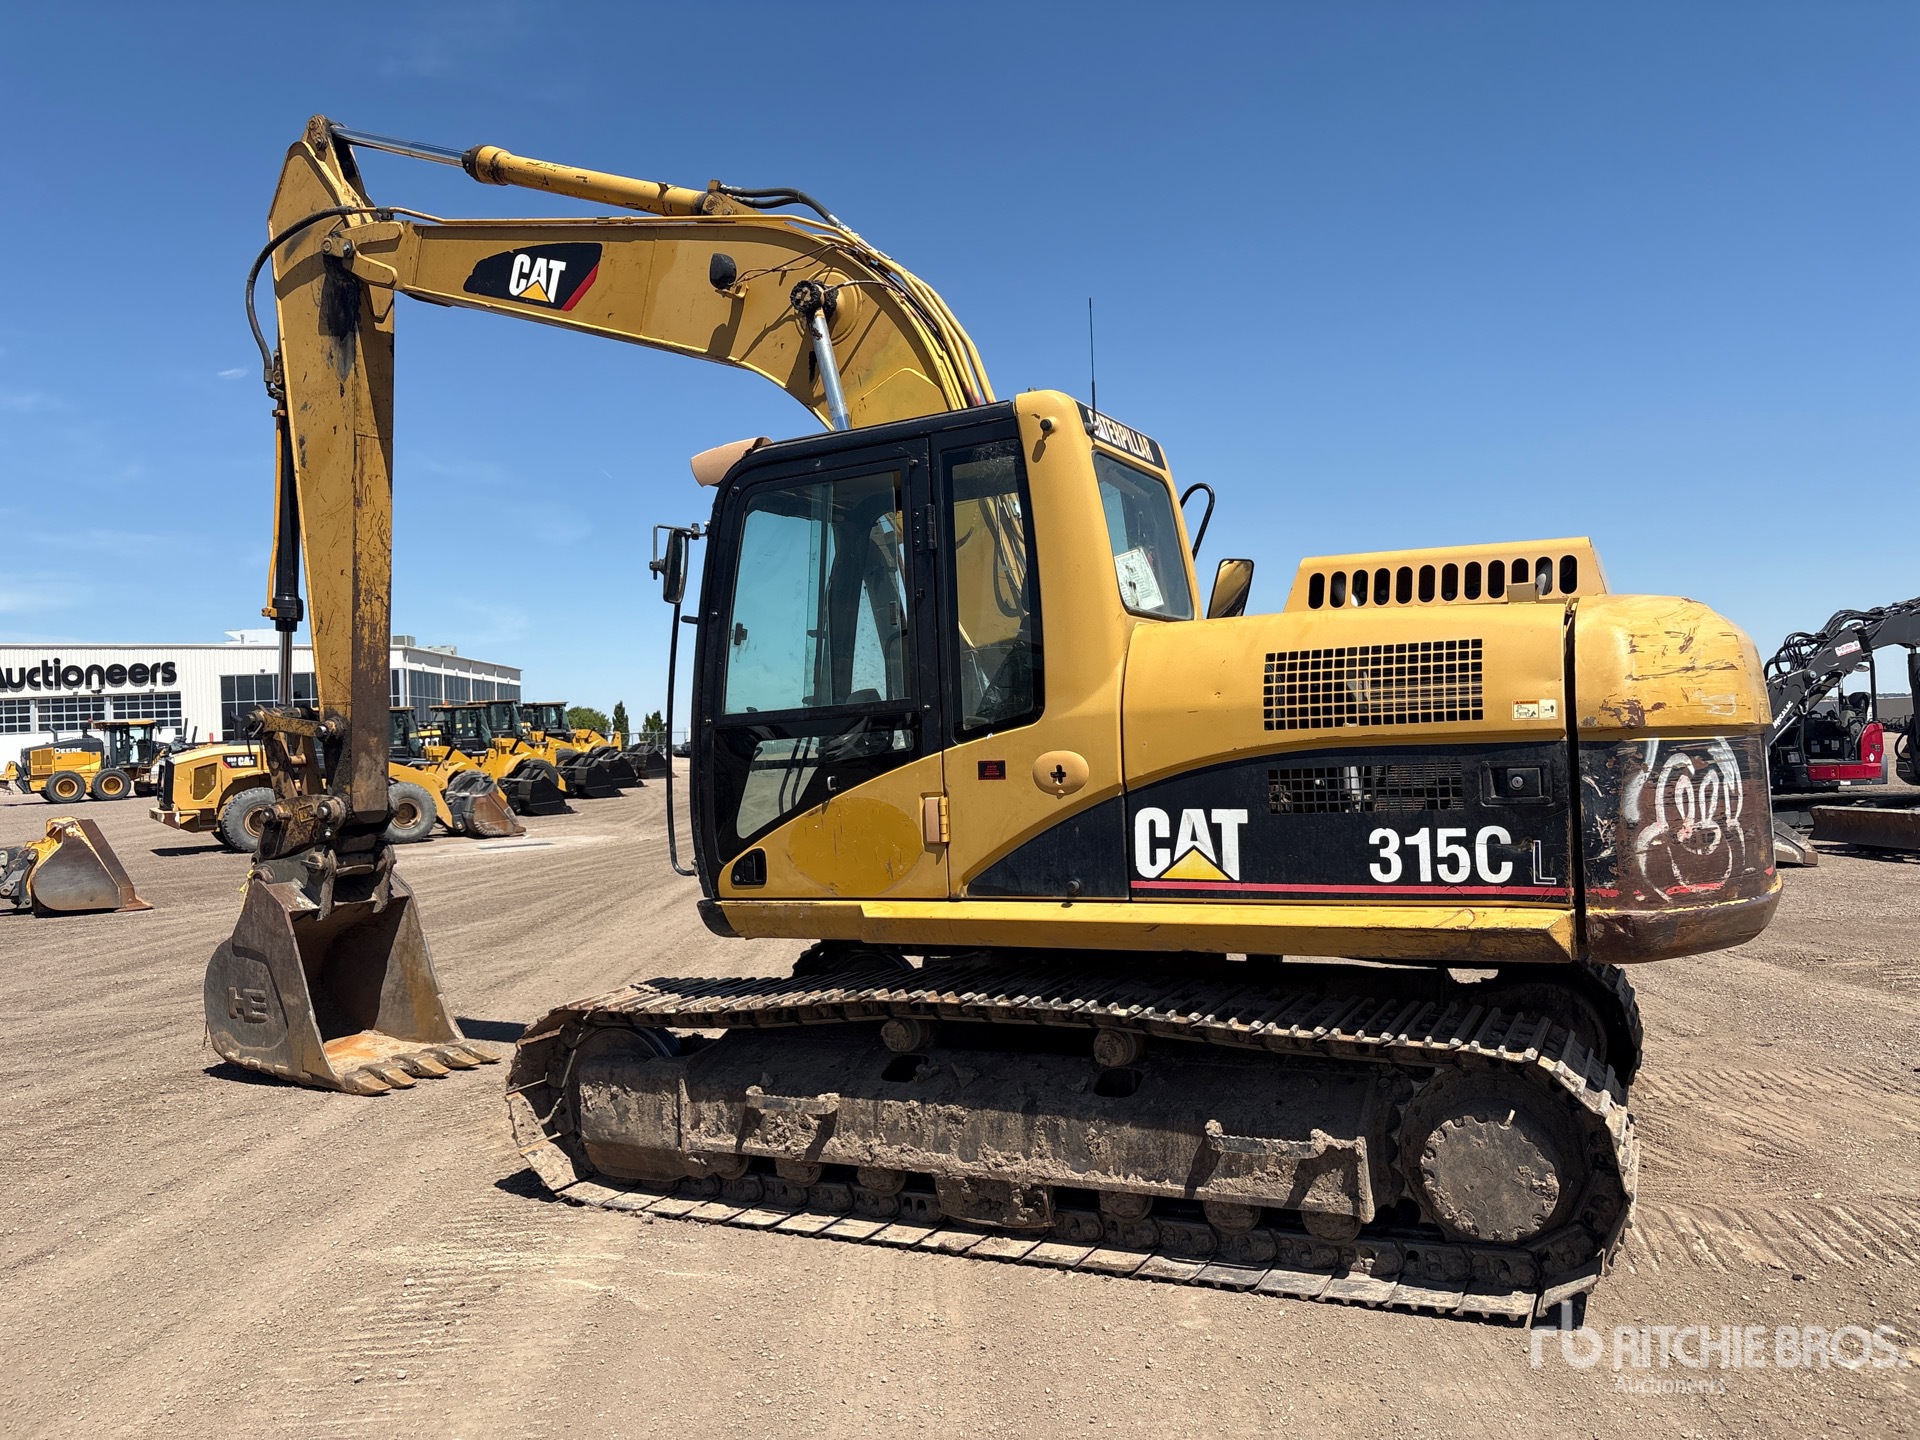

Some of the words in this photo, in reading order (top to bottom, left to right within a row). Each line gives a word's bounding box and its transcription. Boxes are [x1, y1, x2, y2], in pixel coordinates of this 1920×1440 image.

[508, 253, 567, 303] CAT
[1134, 807, 1249, 881] CAT
[1368, 825, 1513, 885] 315C
[1532, 839, 1557, 886] L
